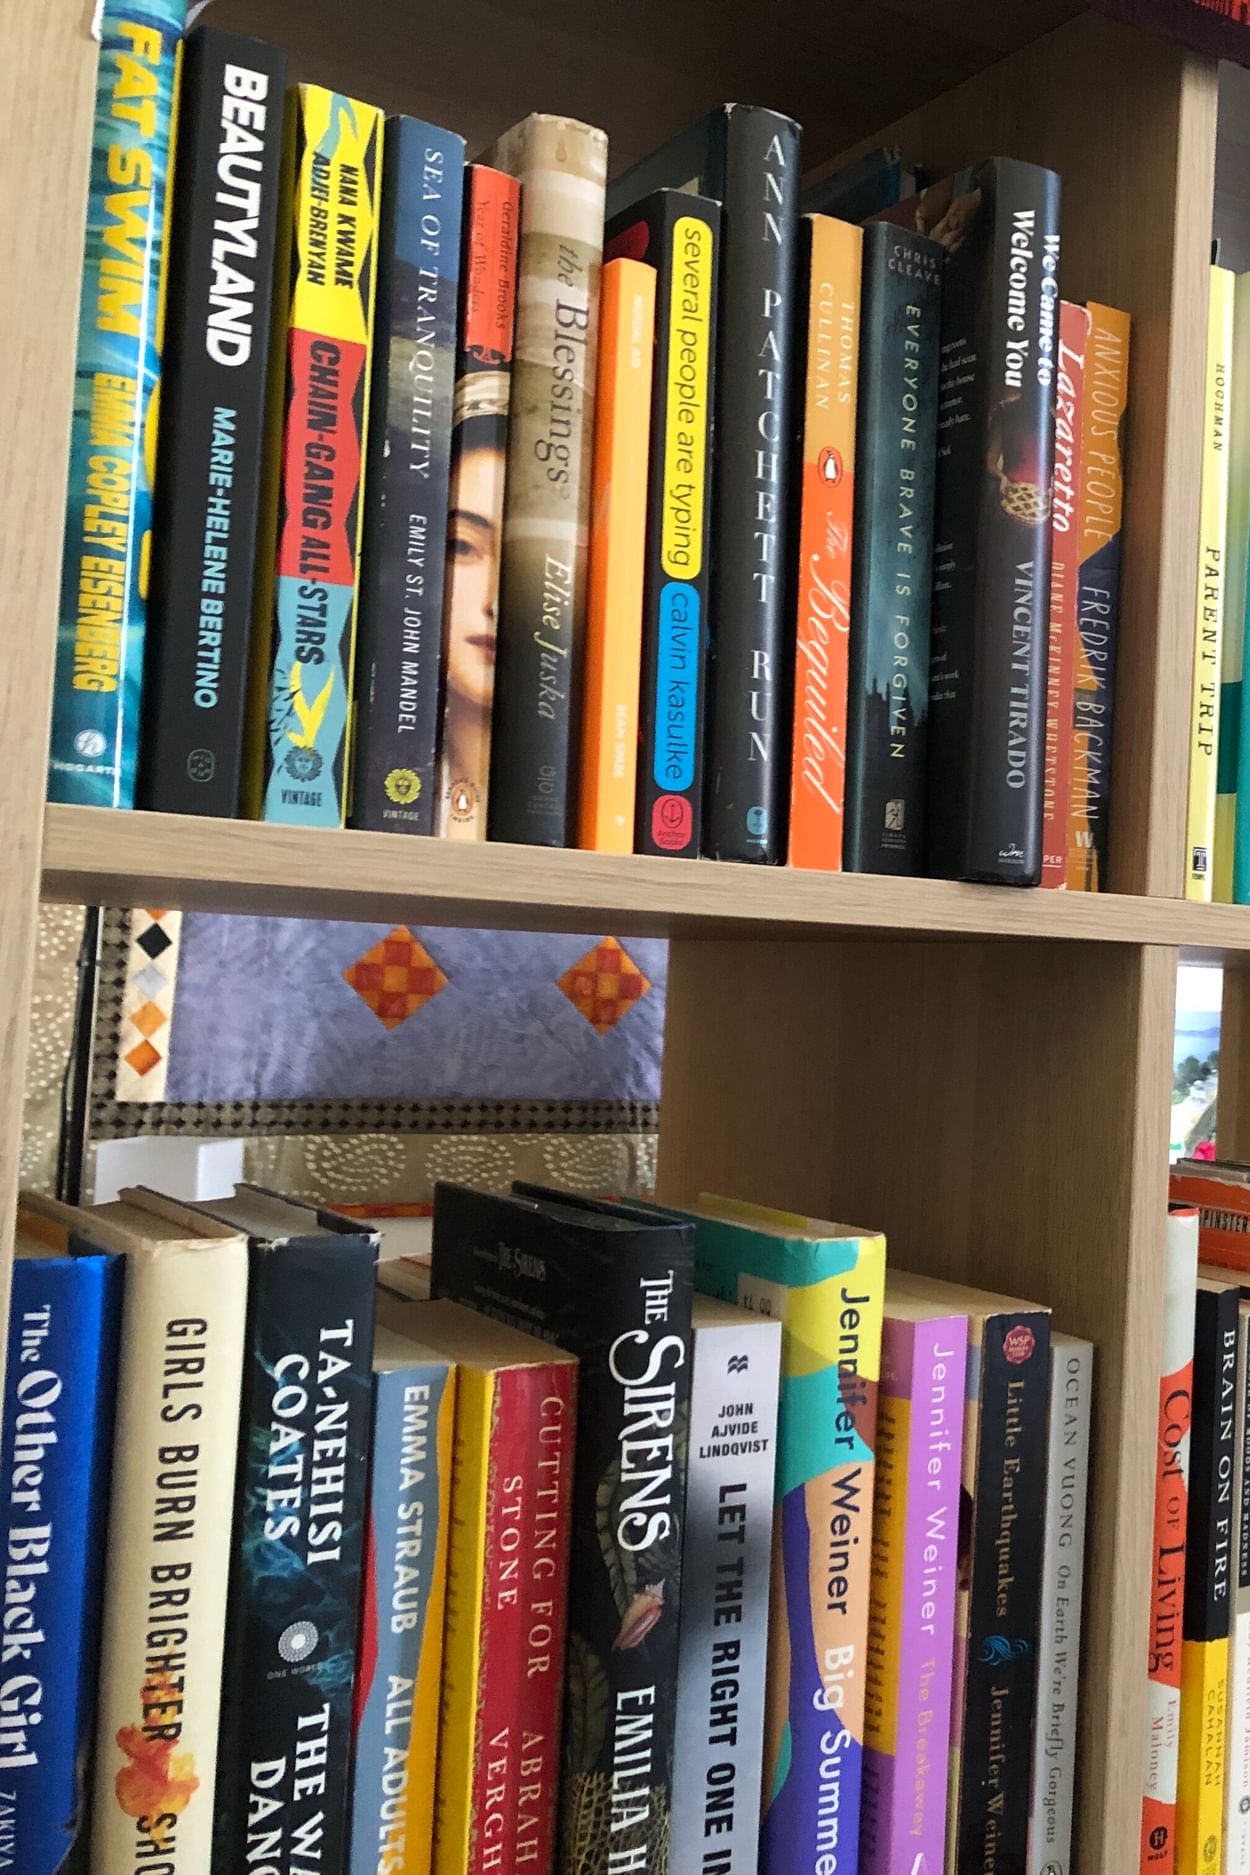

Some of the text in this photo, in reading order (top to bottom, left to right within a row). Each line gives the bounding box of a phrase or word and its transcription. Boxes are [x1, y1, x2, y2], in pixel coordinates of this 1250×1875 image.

[97, 21, 163, 333] FAT SWIM
[205, 63, 269, 368] BEAUTYLAND
[305, 152, 332, 286] ADJEI-BRENYAN
[407, 148, 443, 478] SEA OF TRANQUILITY
[667, 227, 703, 567] several people are typing
[816, 281, 834, 409] CULLINAN
[838, 302, 854, 404] THOMAS
[1005, 209, 1036, 388] Welcome You
[295, 340, 341, 665] CHAIN-GANG ALL-STARS
[890, 304, 921, 759] EVERYONE BRAVE IS FORGIVEN
[1084, 328, 1121, 541] ANXIOUS PEOPLE
[193, 406, 238, 709] MARIE-HELENE BERTINO
[1198, 547, 1221, 756] PARENT TRIP
[665, 593, 694, 779] calvin kasulke
[1006, 561, 1034, 788] VINCENT TIRADO
[1072, 586, 1110, 820] FREDRIK BACKMAN
[264, 1354, 309, 1541] COATES
[307, 1319, 354, 1564] TA-NEHISI
[609, 1270, 686, 1552] THE SIRENS
[700, 1440, 769, 1459] LINDQVIST
[711, 1422, 759, 1438] AJVIDE
[718, 1403, 753, 1419] JOHN
[827, 1287, 870, 1616] Jennifer Weiner
[1213, 1331, 1236, 1601] BRAIN ON FIRE
[0, 1304, 62, 1769] The Other Black Girl
[142, 1317, 207, 1742] GIRLS BURN BRIGHTER
[498, 1475, 523, 1610] STONE
[527, 1396, 564, 1678] CUTTING FOR
[293, 1703, 330, 1801] THE
[610, 1685, 655, 1833] EMILIA
[705, 1483, 747, 1838] LET THE RIGHT ONE
[813, 1643, 854, 1875] Big Summe
[988, 1686, 1009, 1788] Jennifer
[1162, 1700, 1176, 1749] Emily
[1205, 1690, 1215, 1786] CAHALAN
[1213, 1679, 1225, 1786] SUSANNAH
